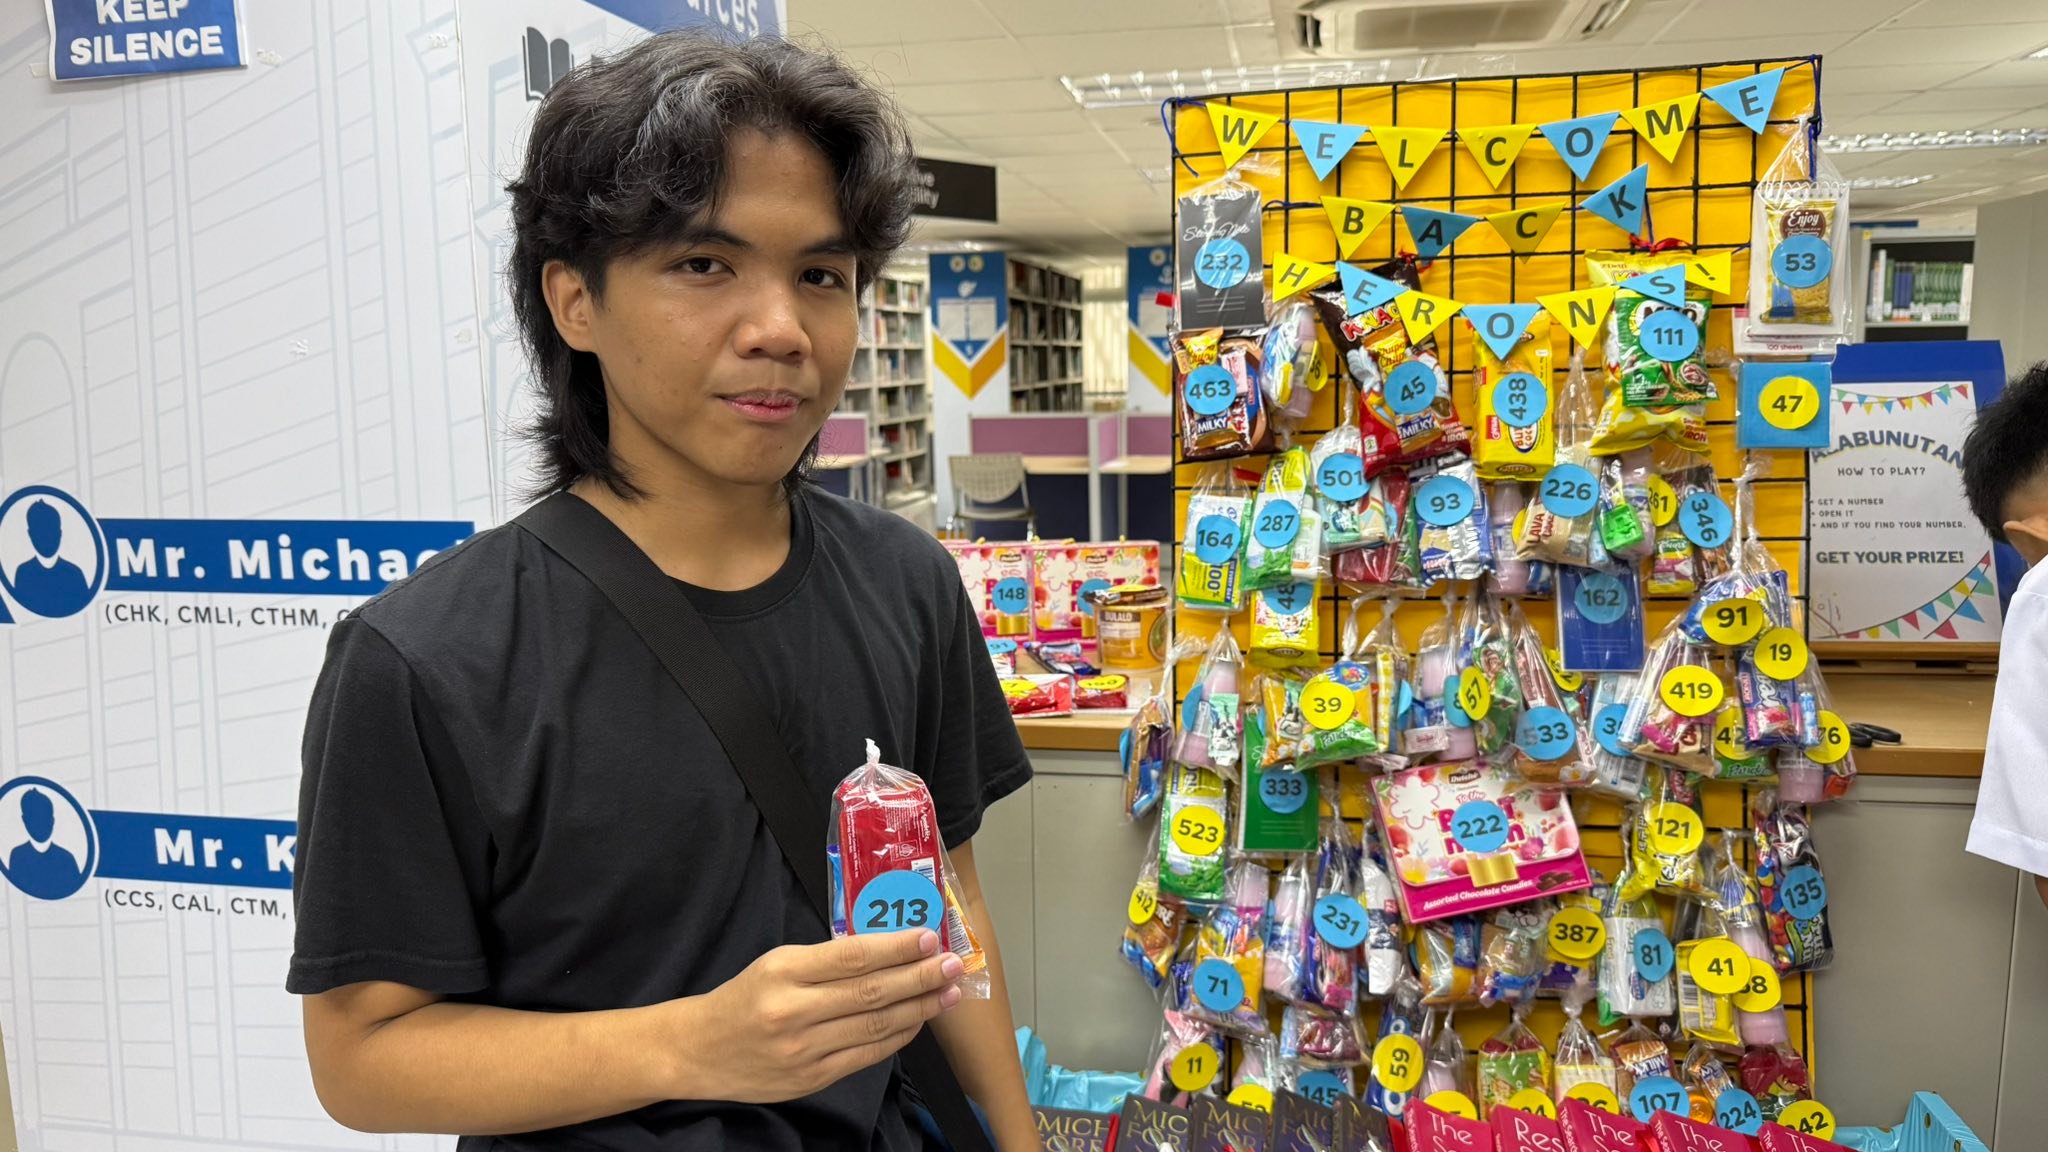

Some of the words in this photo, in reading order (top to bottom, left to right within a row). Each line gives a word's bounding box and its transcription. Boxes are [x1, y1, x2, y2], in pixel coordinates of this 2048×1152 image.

[95, 0, 189, 25] KEEP
[69, 25, 225, 67] SILENCE
[1221, 85, 1764, 169] WELCOME
[1341, 183, 1637, 246] BACK
[1787, 209, 1821, 228] Enjoy
[1201, 254, 1243, 271] 232
[1785, 253, 1817, 272] 53
[1653, 327, 1685, 346] 111
[1189, 380, 1232, 400] 463
[1400, 375, 1427, 402] 45
[1508, 377, 1527, 421] 438
[1771, 395, 1804, 413] 47
[1197, 416, 1227, 433] MILKY
[1400, 417, 1434, 439] MILKY
[1323, 470, 1365, 487] 501
[1837, 467, 1864, 477] HOW
[1871, 467, 1885, 476] TO
[1890, 467, 1926, 477] PLAY?
[1545, 479, 1592, 501] 226
[1430, 493, 1461, 513] 93
[1817, 498, 1836, 506] GET
[1837, 498, 1845, 506] A
[1847, 498, 1885, 506] NUMBER
[1260, 515, 1295, 533] 287
[1691, 498, 1719, 543] 346
[1818, 510, 1843, 518] OPEN
[1845, 510, 1854, 518] IT
[1820, 521, 1839, 530] AND
[1841, 521, 1850, 530] IF
[1853, 521, 1872, 530] YOU
[1874, 521, 1896, 530] FIND
[1898, 521, 1922, 530] YOUR
[1198, 530, 1234, 549] 164
[115, 537, 206, 580] Mr.
[228, 534, 464, 582] Micha
[1816, 551, 1850, 565] GET
[1854, 551, 1903, 565] YOUR
[1905, 550, 1965, 565] PRIZE!
[997, 587, 1026, 600] 148
[1583, 589, 1620, 607] 162
[105, 603, 169, 626] (CHK,
[178, 605, 240, 627] CMLI,
[250, 607, 327, 630] CTHM,
[1716, 606, 1748, 628] 91
[1768, 643, 1793, 662] 19
[1464, 677, 1483, 710] 57
[1669, 682, 1714, 700] 419
[1312, 697, 1342, 713] 39
[1716, 726, 1746, 746] 42
[1265, 778, 1303, 797] 333
[1177, 818, 1220, 844] 523
[1457, 813, 1504, 839] 222
[1653, 816, 1691, 840] 121
[153, 827, 244, 870] Mr.
[105, 888, 163, 911] (CCS,
[171, 892, 223, 914] CAL,
[230, 896, 287, 919] CTM,
[1423, 893, 1459, 911] Assorted
[1459, 886, 1500, 902] Chocolate
[1500, 878, 1534, 894] Candies
[1783, 878, 1823, 909] 135
[866, 898, 929, 929] 213
[1321, 904, 1361, 938] 231
[1554, 923, 1599, 944] 387
[1640, 943, 1663, 967] 81
[1706, 957, 1735, 977] 41
[1207, 975, 1229, 997] 71
[1186, 1056, 1203, 1074] 11
[1389, 1047, 1410, 1079] 59
[1638, 1091, 1682, 1114] 107
[1720, 1099, 1757, 1129] 224
[1784, 1110, 1829, 1134] 42
[1427, 1110, 1473, 1146] The
[1583, 1109, 1635, 1147] The
[1673, 1120, 1724, 1151] The
